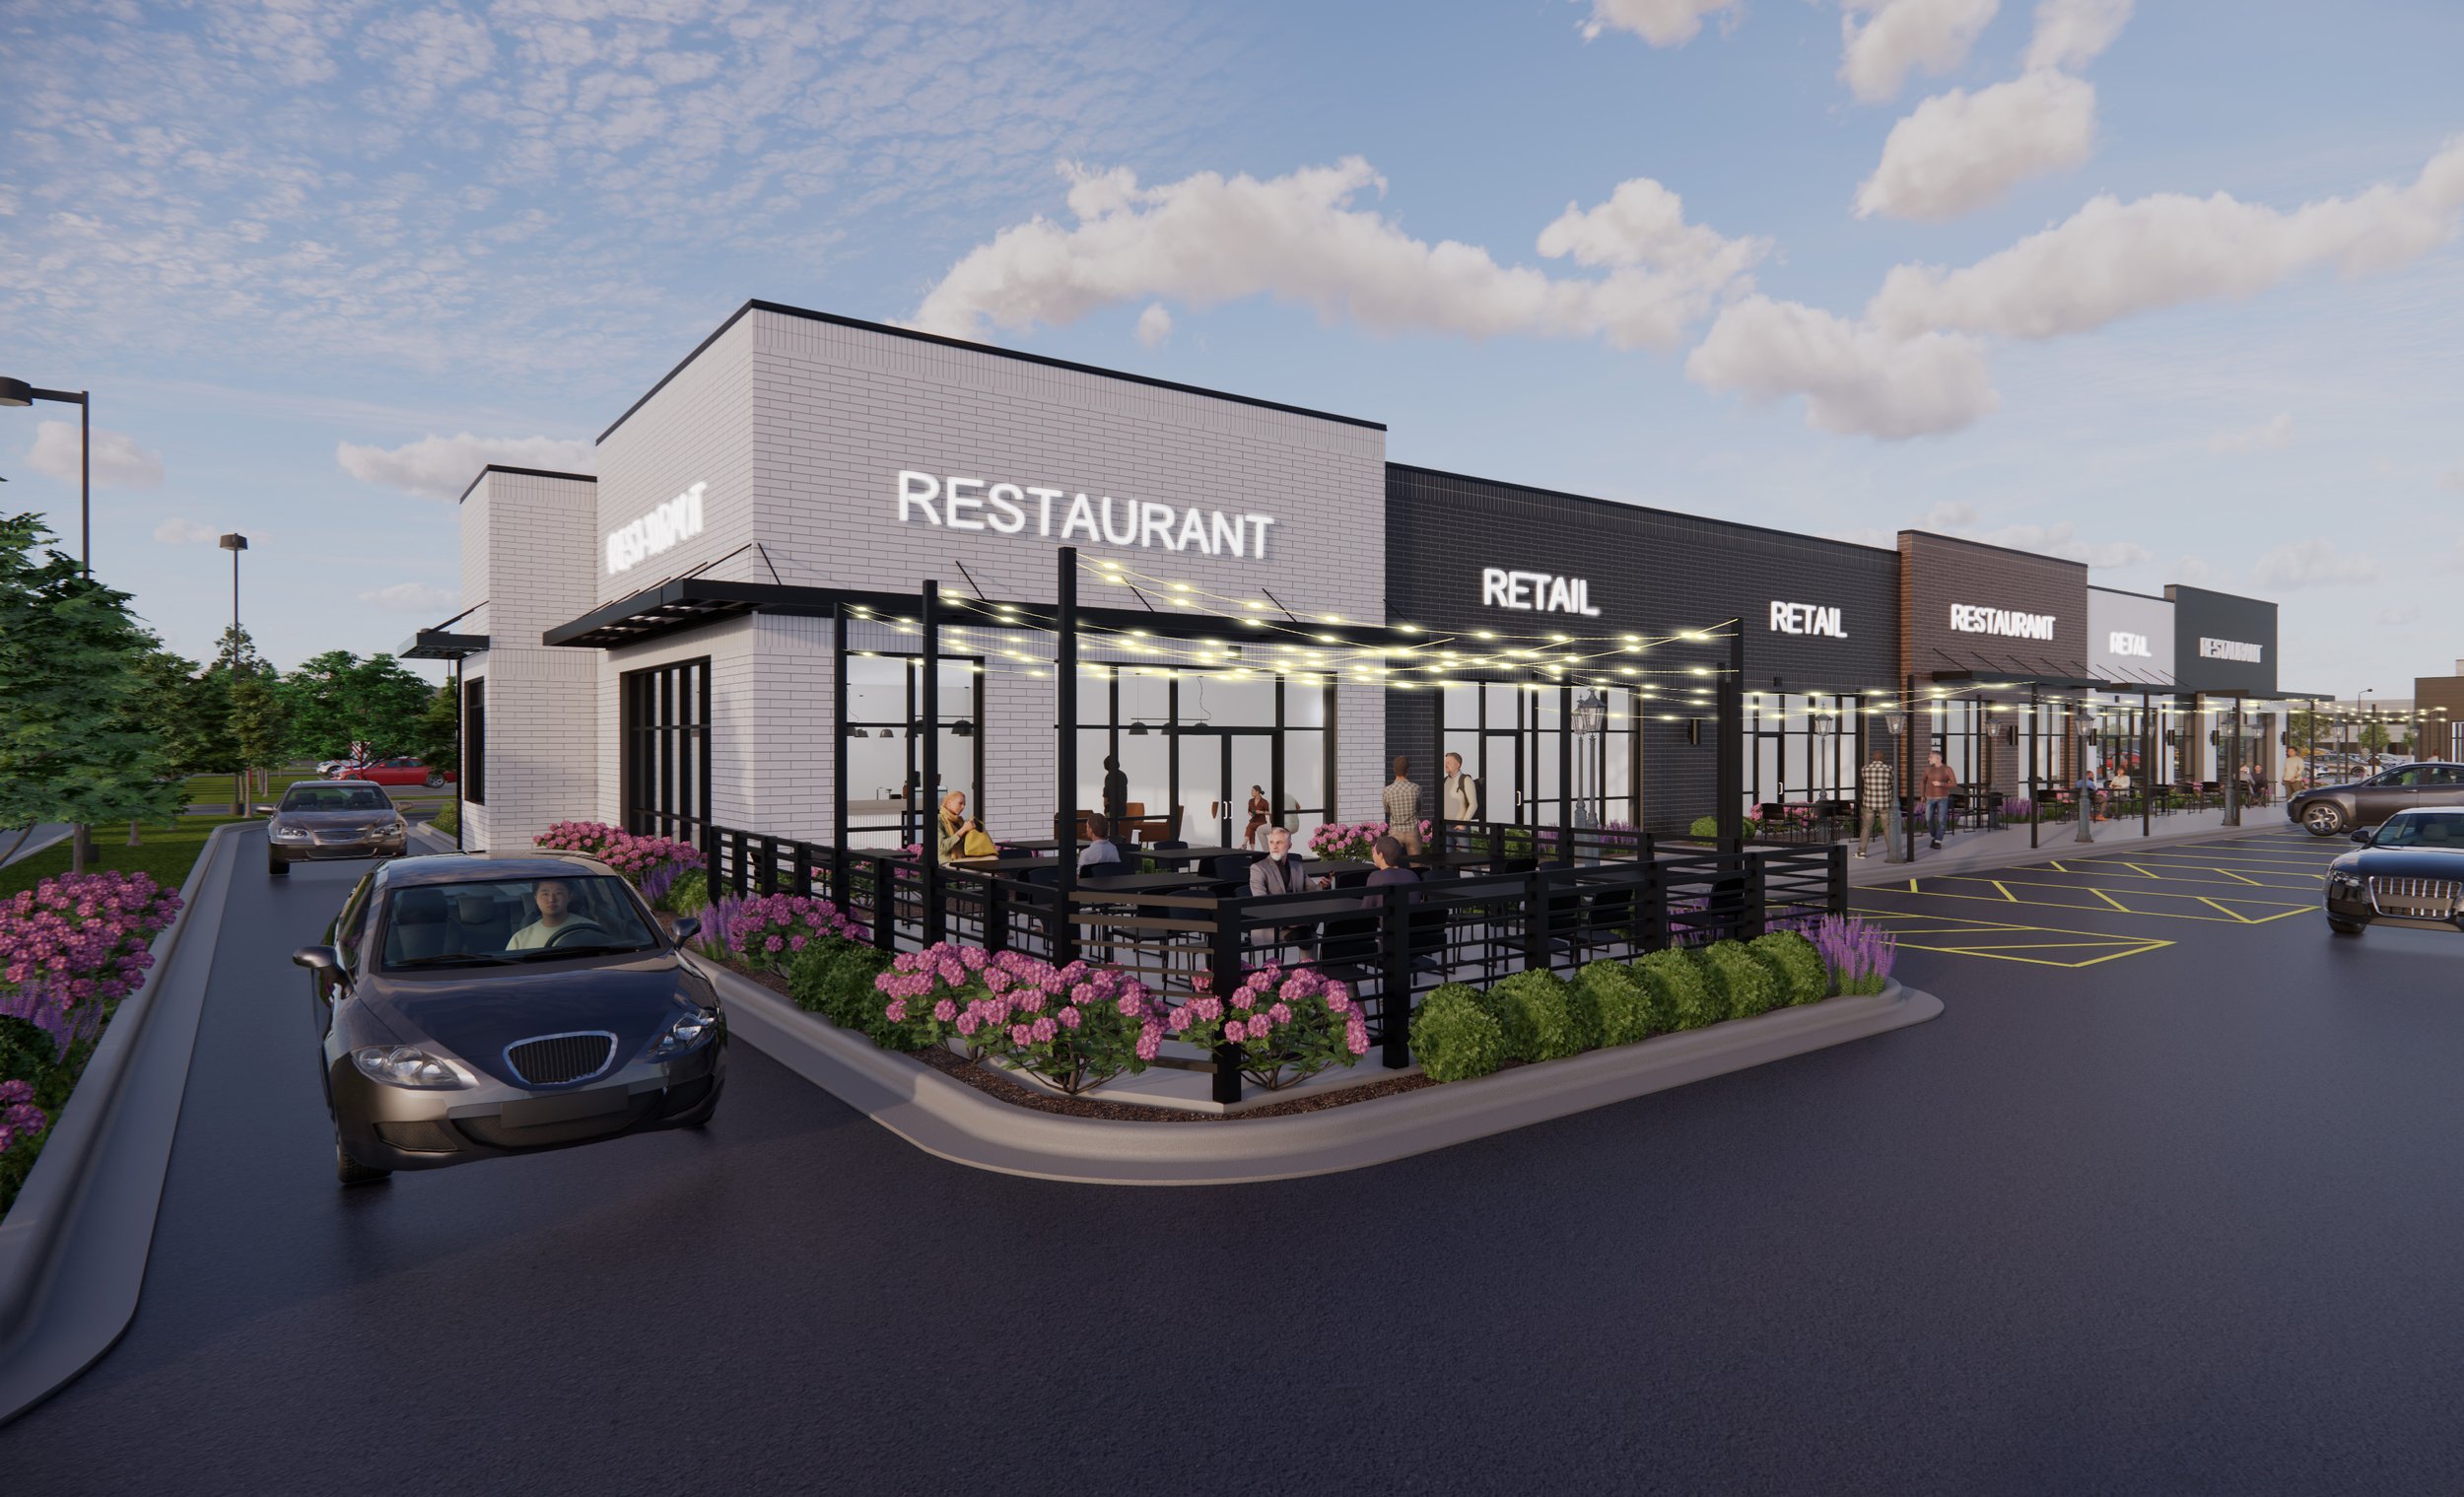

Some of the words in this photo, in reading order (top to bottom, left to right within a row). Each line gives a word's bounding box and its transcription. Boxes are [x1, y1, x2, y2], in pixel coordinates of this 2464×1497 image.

[897, 469, 1275, 559] RESTAURANT
[1482, 568, 1601, 616] RETAIL
[1770, 600, 1848, 638] RETAIL
[1950, 603, 2056, 641] RESTAURANT
